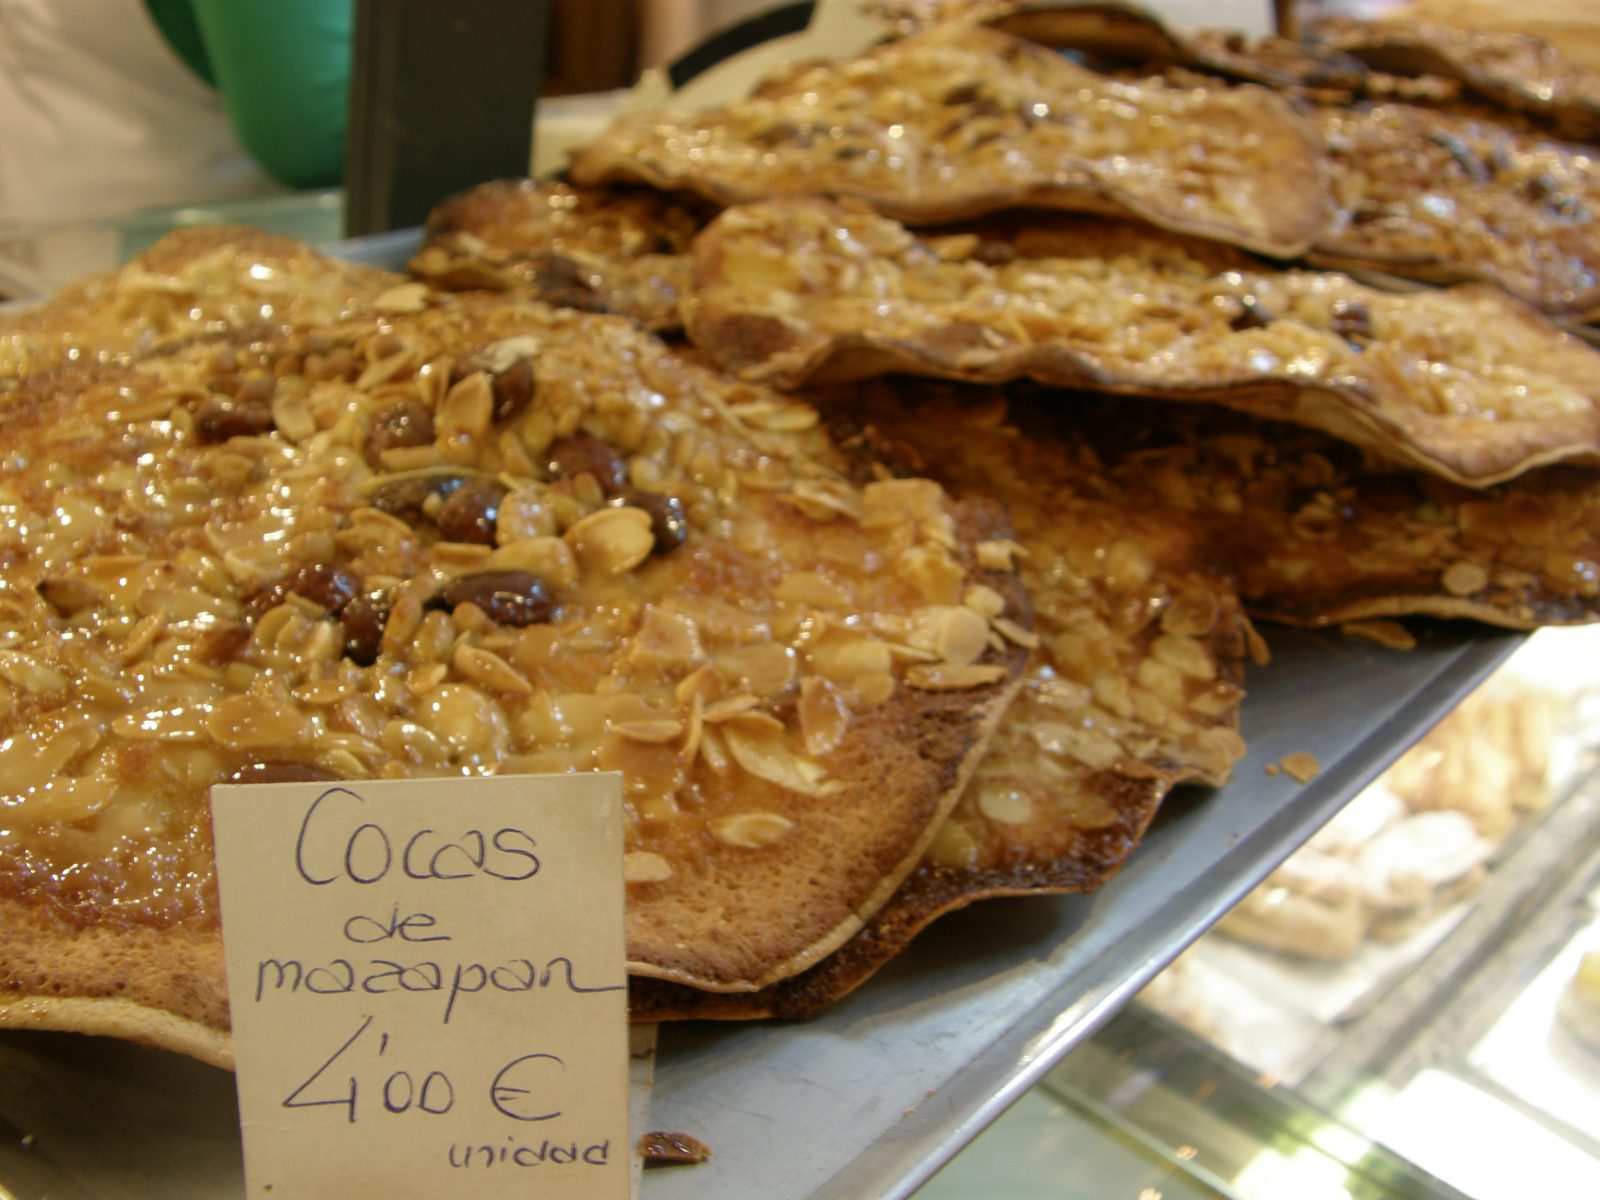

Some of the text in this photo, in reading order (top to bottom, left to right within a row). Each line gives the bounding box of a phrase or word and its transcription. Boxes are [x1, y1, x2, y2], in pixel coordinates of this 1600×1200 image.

[296, 787, 541, 885] Cocas
[344, 902, 451, 942] de
[255, 957, 626, 1024] mazapan
[490, 1054, 564, 1120] €
[449, 1136, 610, 1168] unidad
